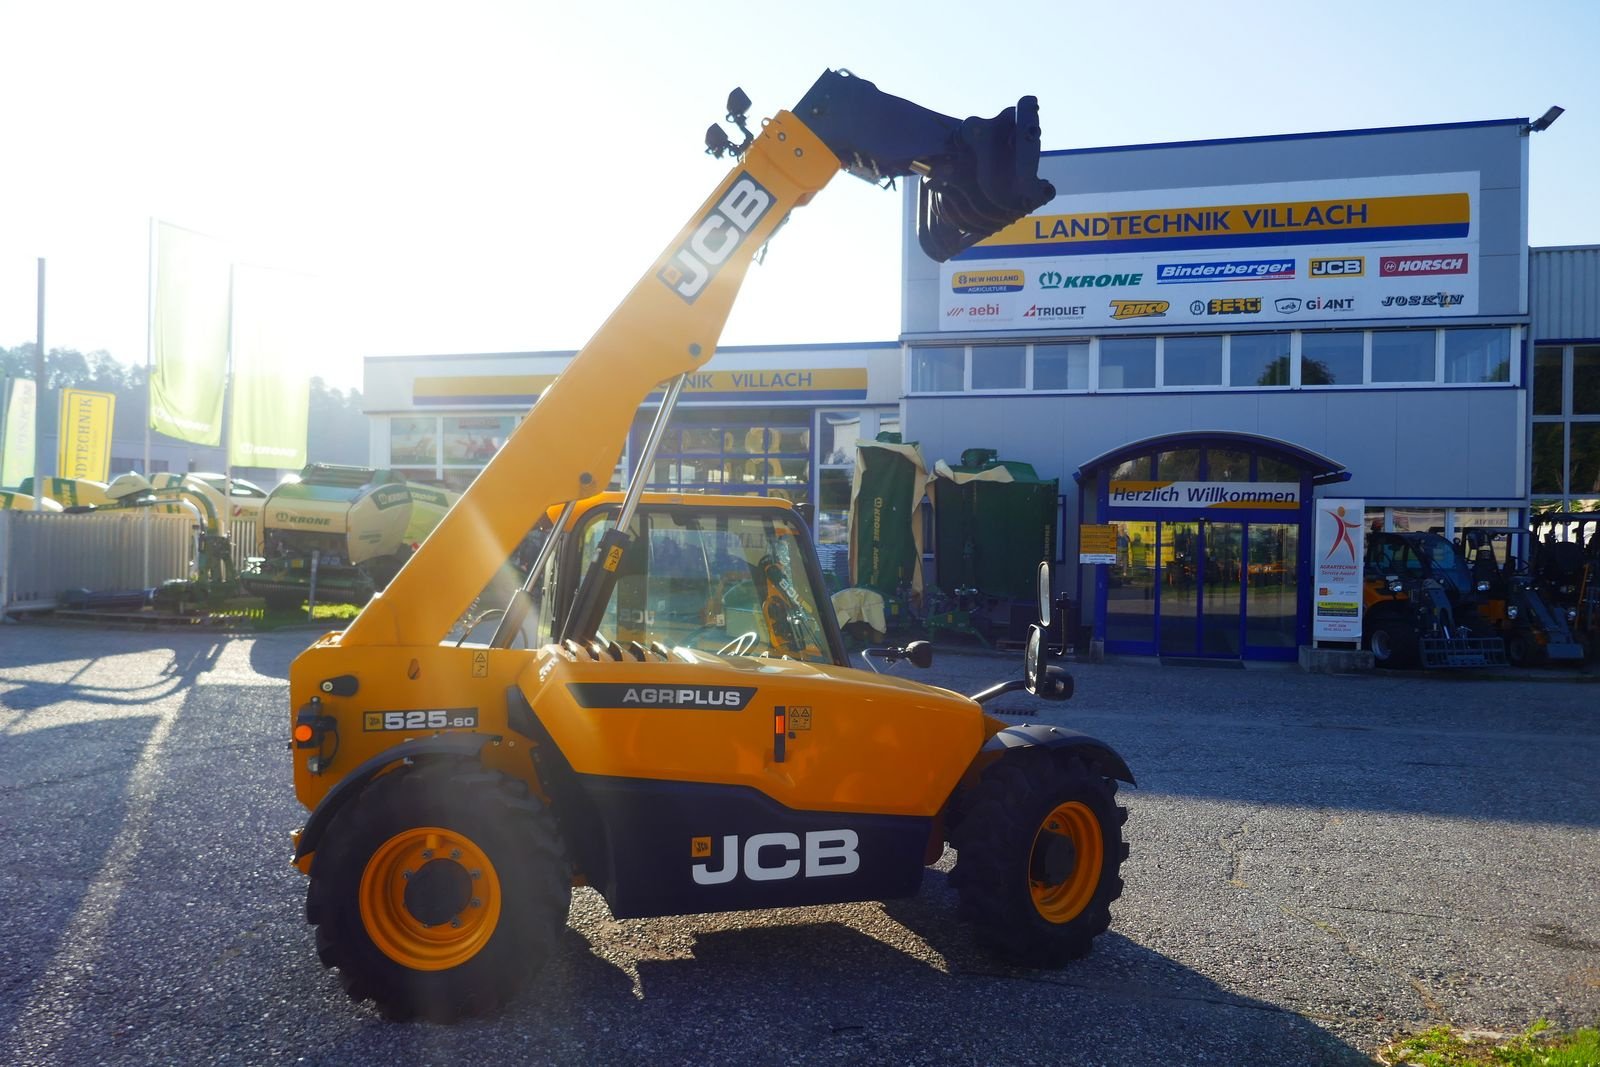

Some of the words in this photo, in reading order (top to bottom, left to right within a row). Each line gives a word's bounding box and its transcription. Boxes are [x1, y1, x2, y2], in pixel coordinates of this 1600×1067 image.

[1035, 210, 1231, 240] LANDTECHNIK
[1243, 203, 1368, 229] VILLACH
[677, 179, 770, 297] JCB
[1161, 263, 1292, 277] Binderberger
[1312, 260, 1361, 275] JCB
[1397, 258, 1463, 272] HORSCH
[986, 275, 1019, 283] HOLLAND
[1063, 273, 1144, 288] KRONE
[1381, 293, 1464, 307] JOSKIN
[968, 304, 1000, 316] aebi
[1110, 301, 1170, 319] Tanco
[731, 372, 812, 388] VILLACH
[74, 397, 92, 479] NDTECHNIK
[1113, 487, 1179, 502] Herzlich
[1187, 487, 1296, 503] Willkommen
[289, 516, 331, 526] KRONE
[873, 508, 881, 542] KRONE
[622, 688, 741, 706] AGRIPLUS
[692, 828, 861, 885] JCB
